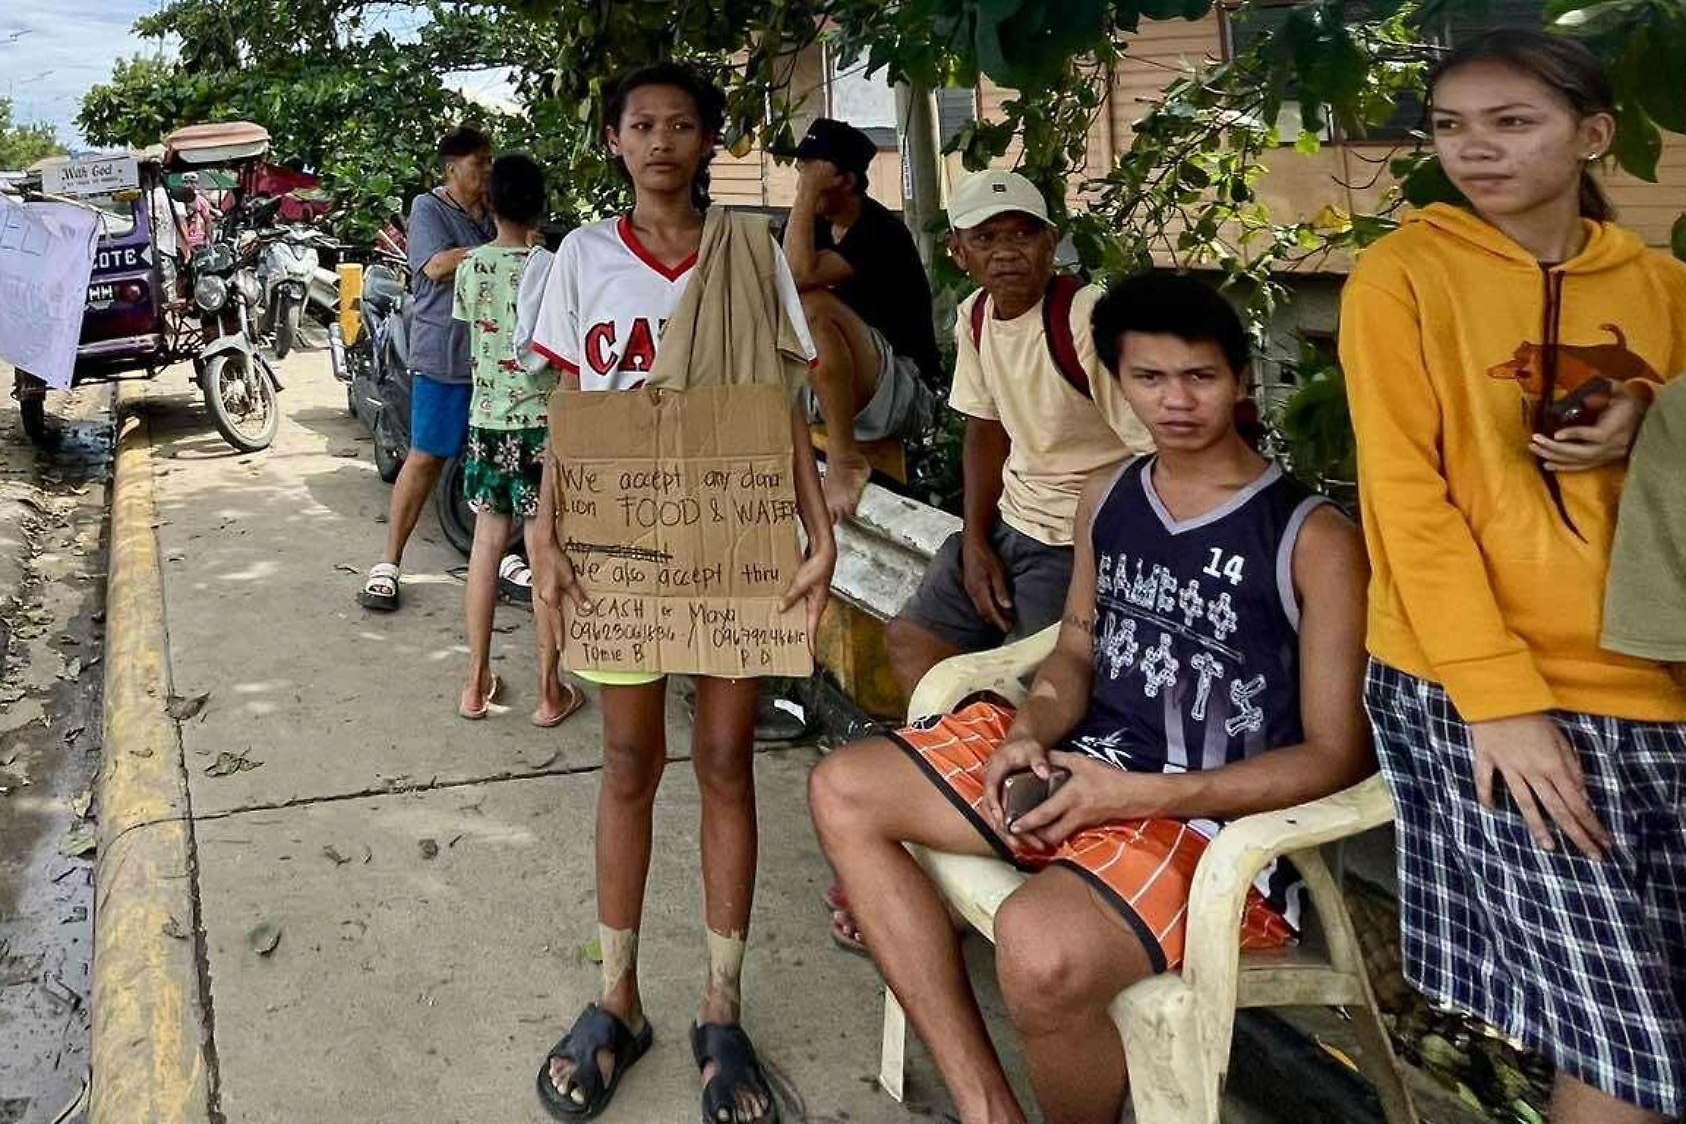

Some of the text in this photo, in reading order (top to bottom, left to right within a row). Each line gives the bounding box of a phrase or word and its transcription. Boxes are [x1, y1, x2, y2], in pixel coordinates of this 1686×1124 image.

[561, 463, 601, 493] We
[619, 463, 680, 495] accept
[616, 493, 701, 528] FOOD
[709, 497, 725, 523] &
[612, 561, 646, 588] also
[657, 563, 722, 590] accept
[741, 562, 780, 586] thru
[1203, 546, 1246, 586] 14
